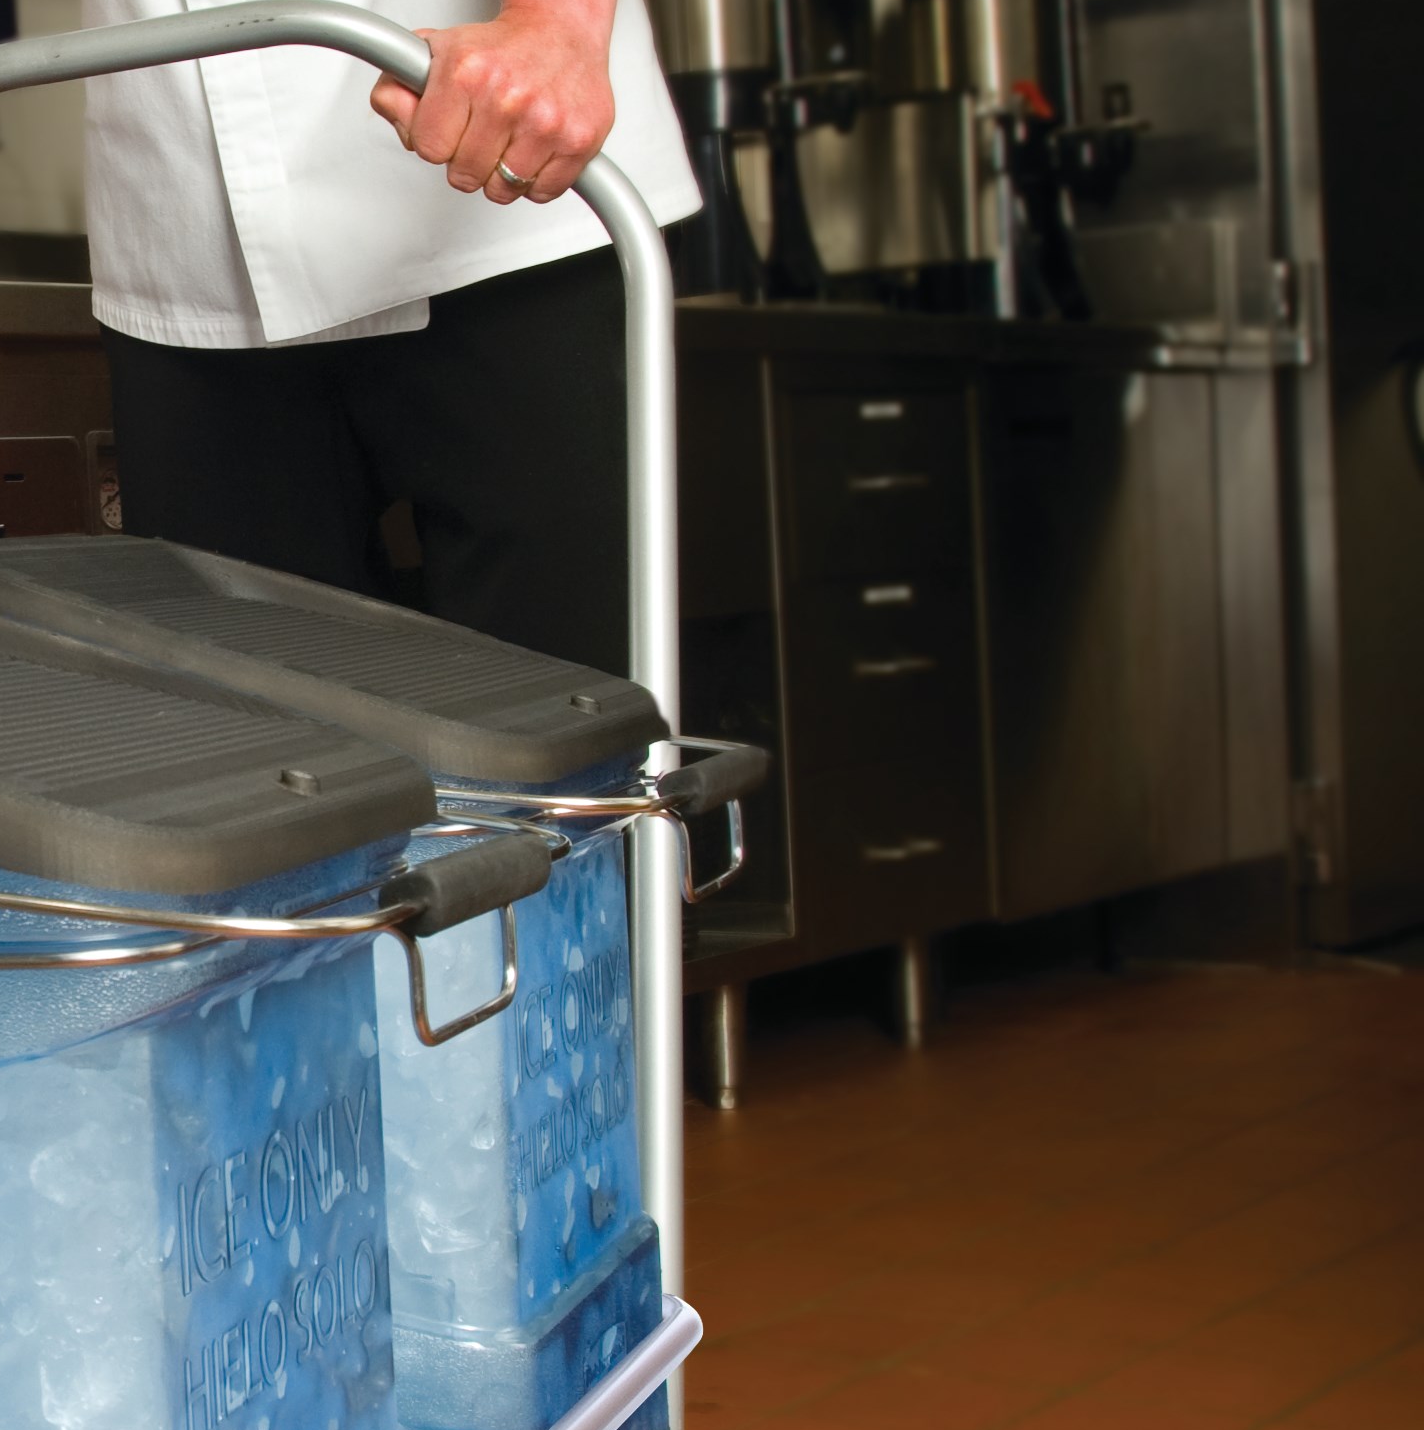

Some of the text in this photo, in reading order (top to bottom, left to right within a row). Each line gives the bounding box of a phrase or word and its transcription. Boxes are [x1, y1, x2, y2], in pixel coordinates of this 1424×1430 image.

[514, 946, 622, 1085] ICE ONLY
[176, 1087, 369, 1298] ICE ONLY
[518, 1061, 628, 1195] HIELO SOLO
[294, 1238, 376, 1365] SOLO
